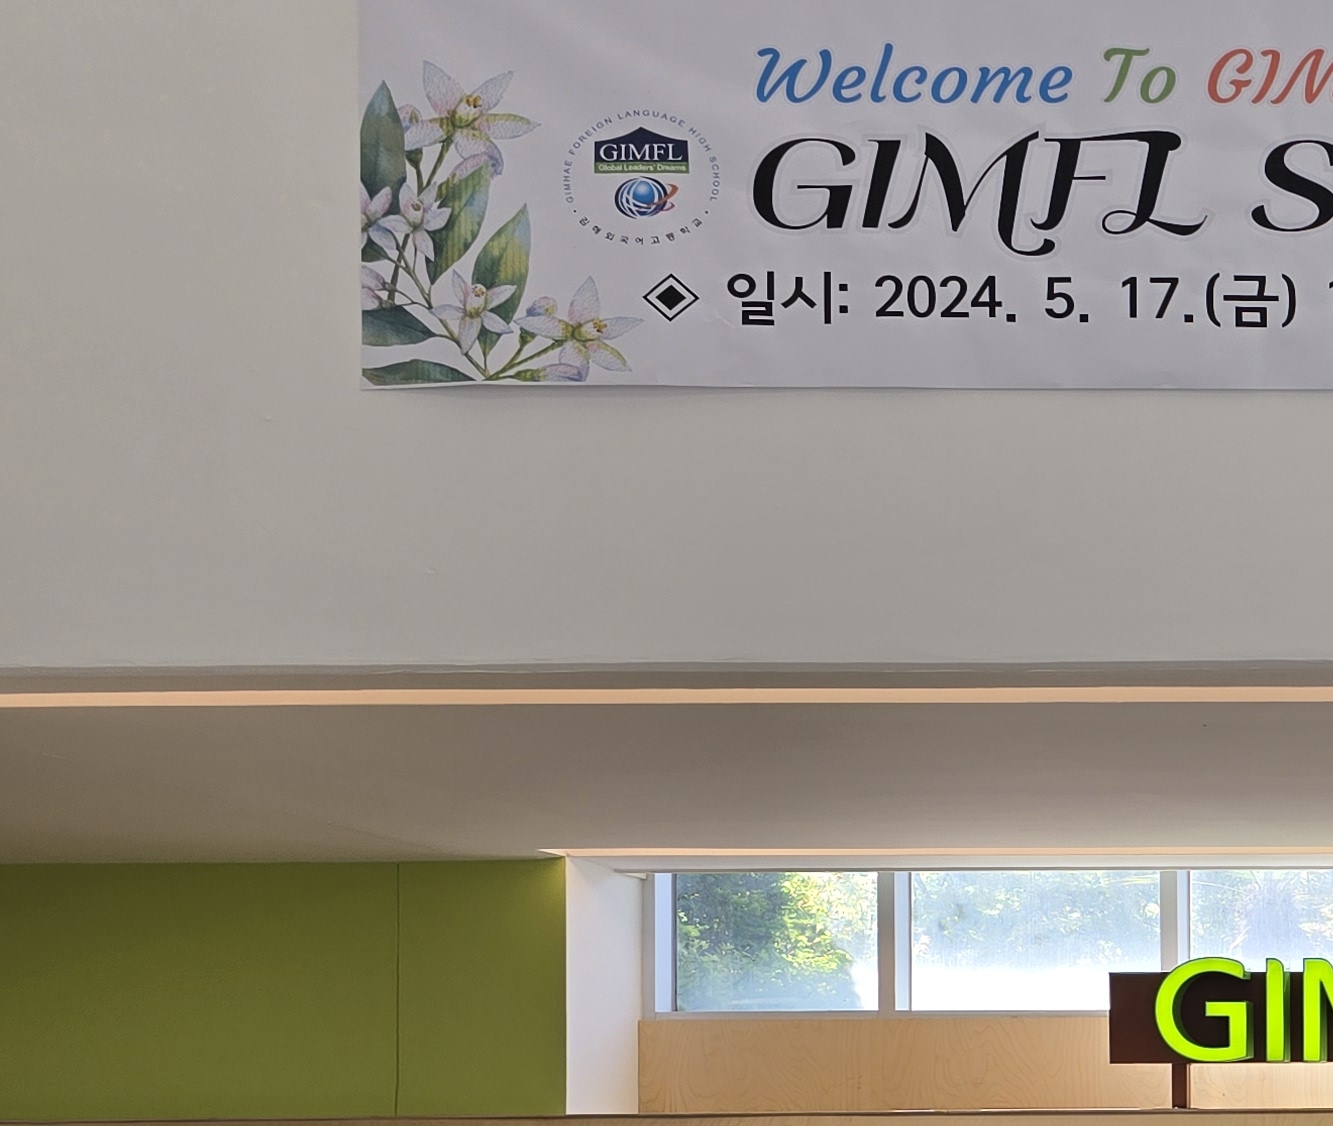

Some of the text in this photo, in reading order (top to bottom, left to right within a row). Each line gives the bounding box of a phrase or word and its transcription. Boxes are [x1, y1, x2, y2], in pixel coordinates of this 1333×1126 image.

[755, 43, 1073, 104] Welcome
[1103, 47, 1176, 105] To
[568, 116, 613, 156] FOREIGN
[617, 109, 687, 128] LANGUAGE
[599, 143, 684, 162] GIMFL
[688, 127, 712, 153] HIGH
[562, 160, 573, 204] GIMHAE
[597, 163, 623, 172] Global
[657, 163, 687, 172] Dreams
[709, 156, 721, 203] SCHOOL
[752, 131, 1208, 257] GIMFL
[726, 270, 850, 327] 일시:
[874, 274, 1018, 323] 2024.
[1044, 276, 1090, 323] 5.
